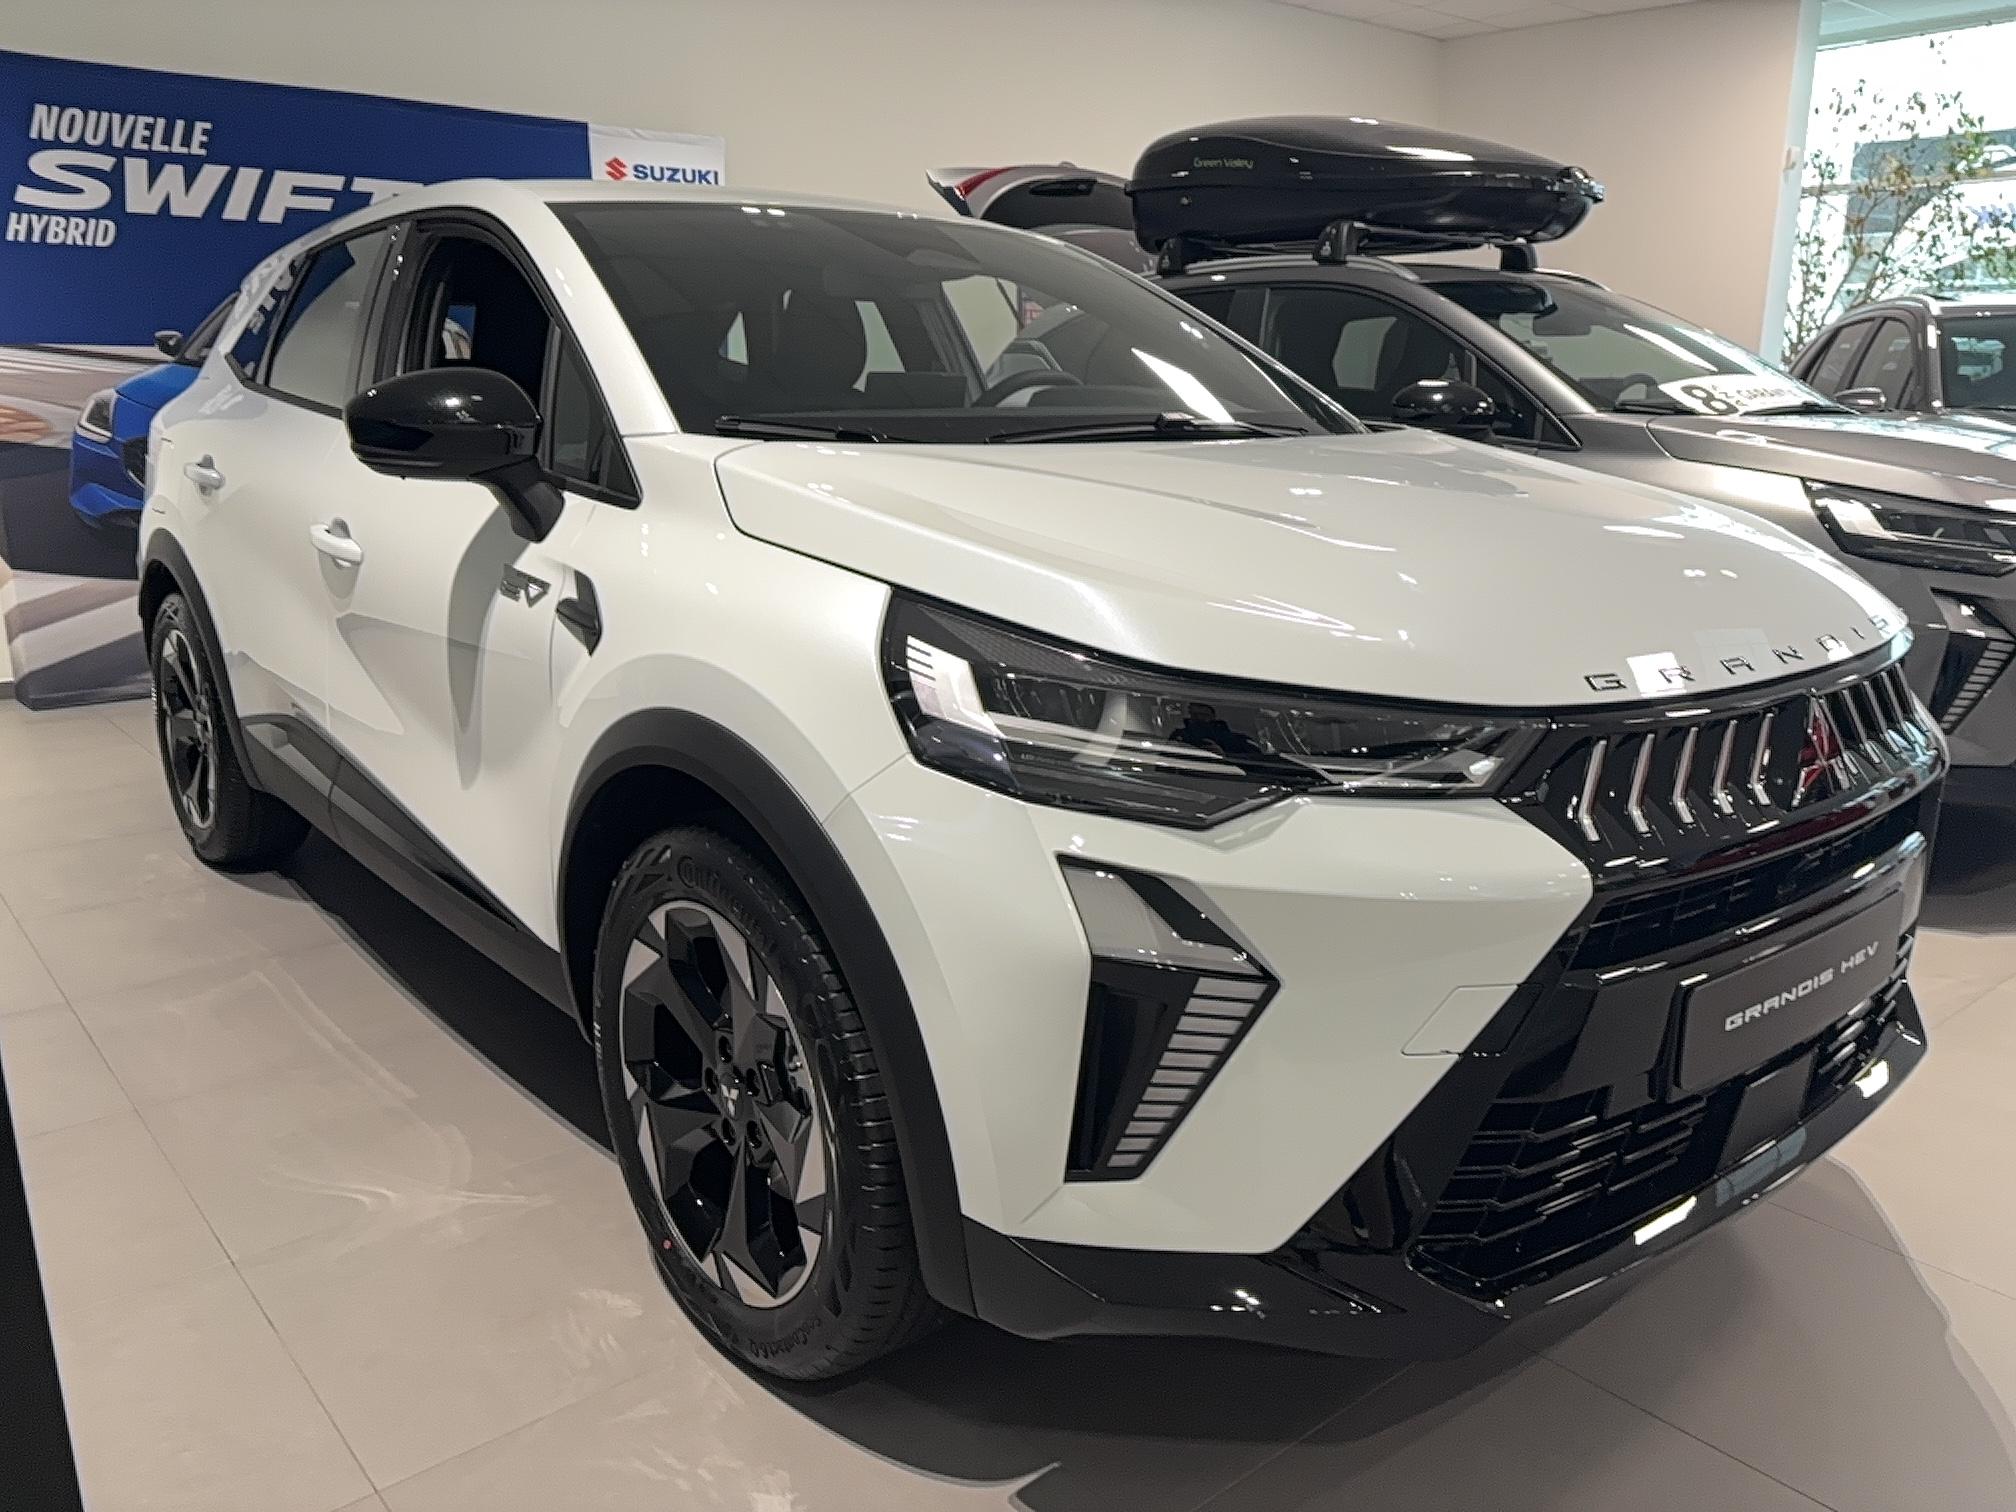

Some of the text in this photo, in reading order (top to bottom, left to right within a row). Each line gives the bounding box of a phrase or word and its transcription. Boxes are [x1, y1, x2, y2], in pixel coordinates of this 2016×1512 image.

[29, 103, 213, 156] NOUVELLE
[633, 163, 719, 186] SUZUKI
[1194, 157, 1222, 168] Green
[5, 212, 117, 248] HYBRID
[1583, 614, 1892, 692] GRANDIS
[1723, 941, 1880, 1032] GRANDIS HEV
